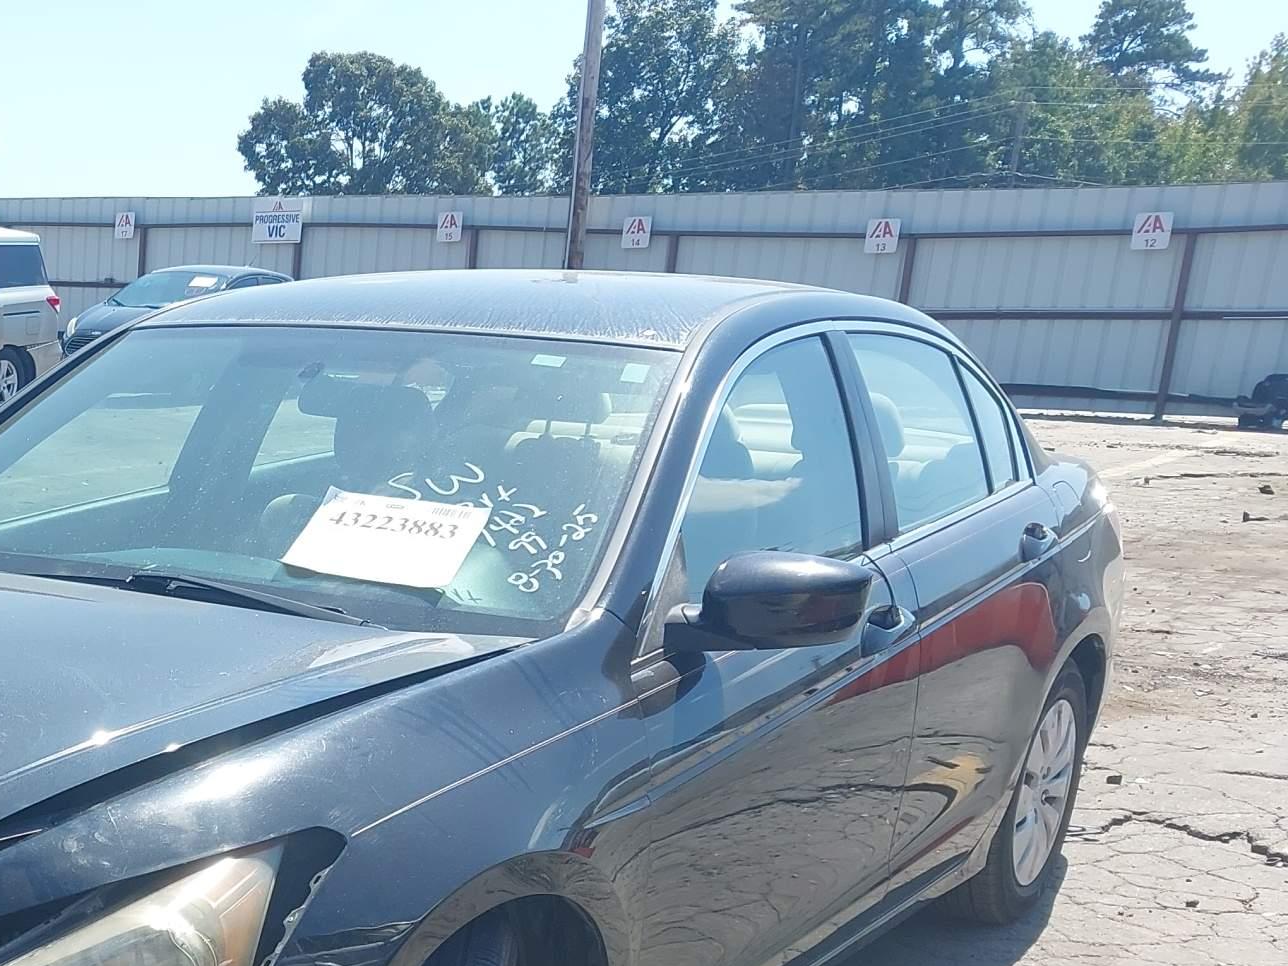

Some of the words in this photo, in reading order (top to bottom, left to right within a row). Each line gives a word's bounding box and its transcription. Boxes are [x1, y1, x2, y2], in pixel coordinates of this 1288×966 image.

[255, 213, 300, 224] PROGRESSIVE
[267, 225, 286, 238] VIC
[445, 232, 453, 241] 15
[631, 238, 640, 247] 14
[875, 242, 886, 252] 13
[1143, 238, 1157, 248] 12
[329, 511, 460, 539] 43223883
